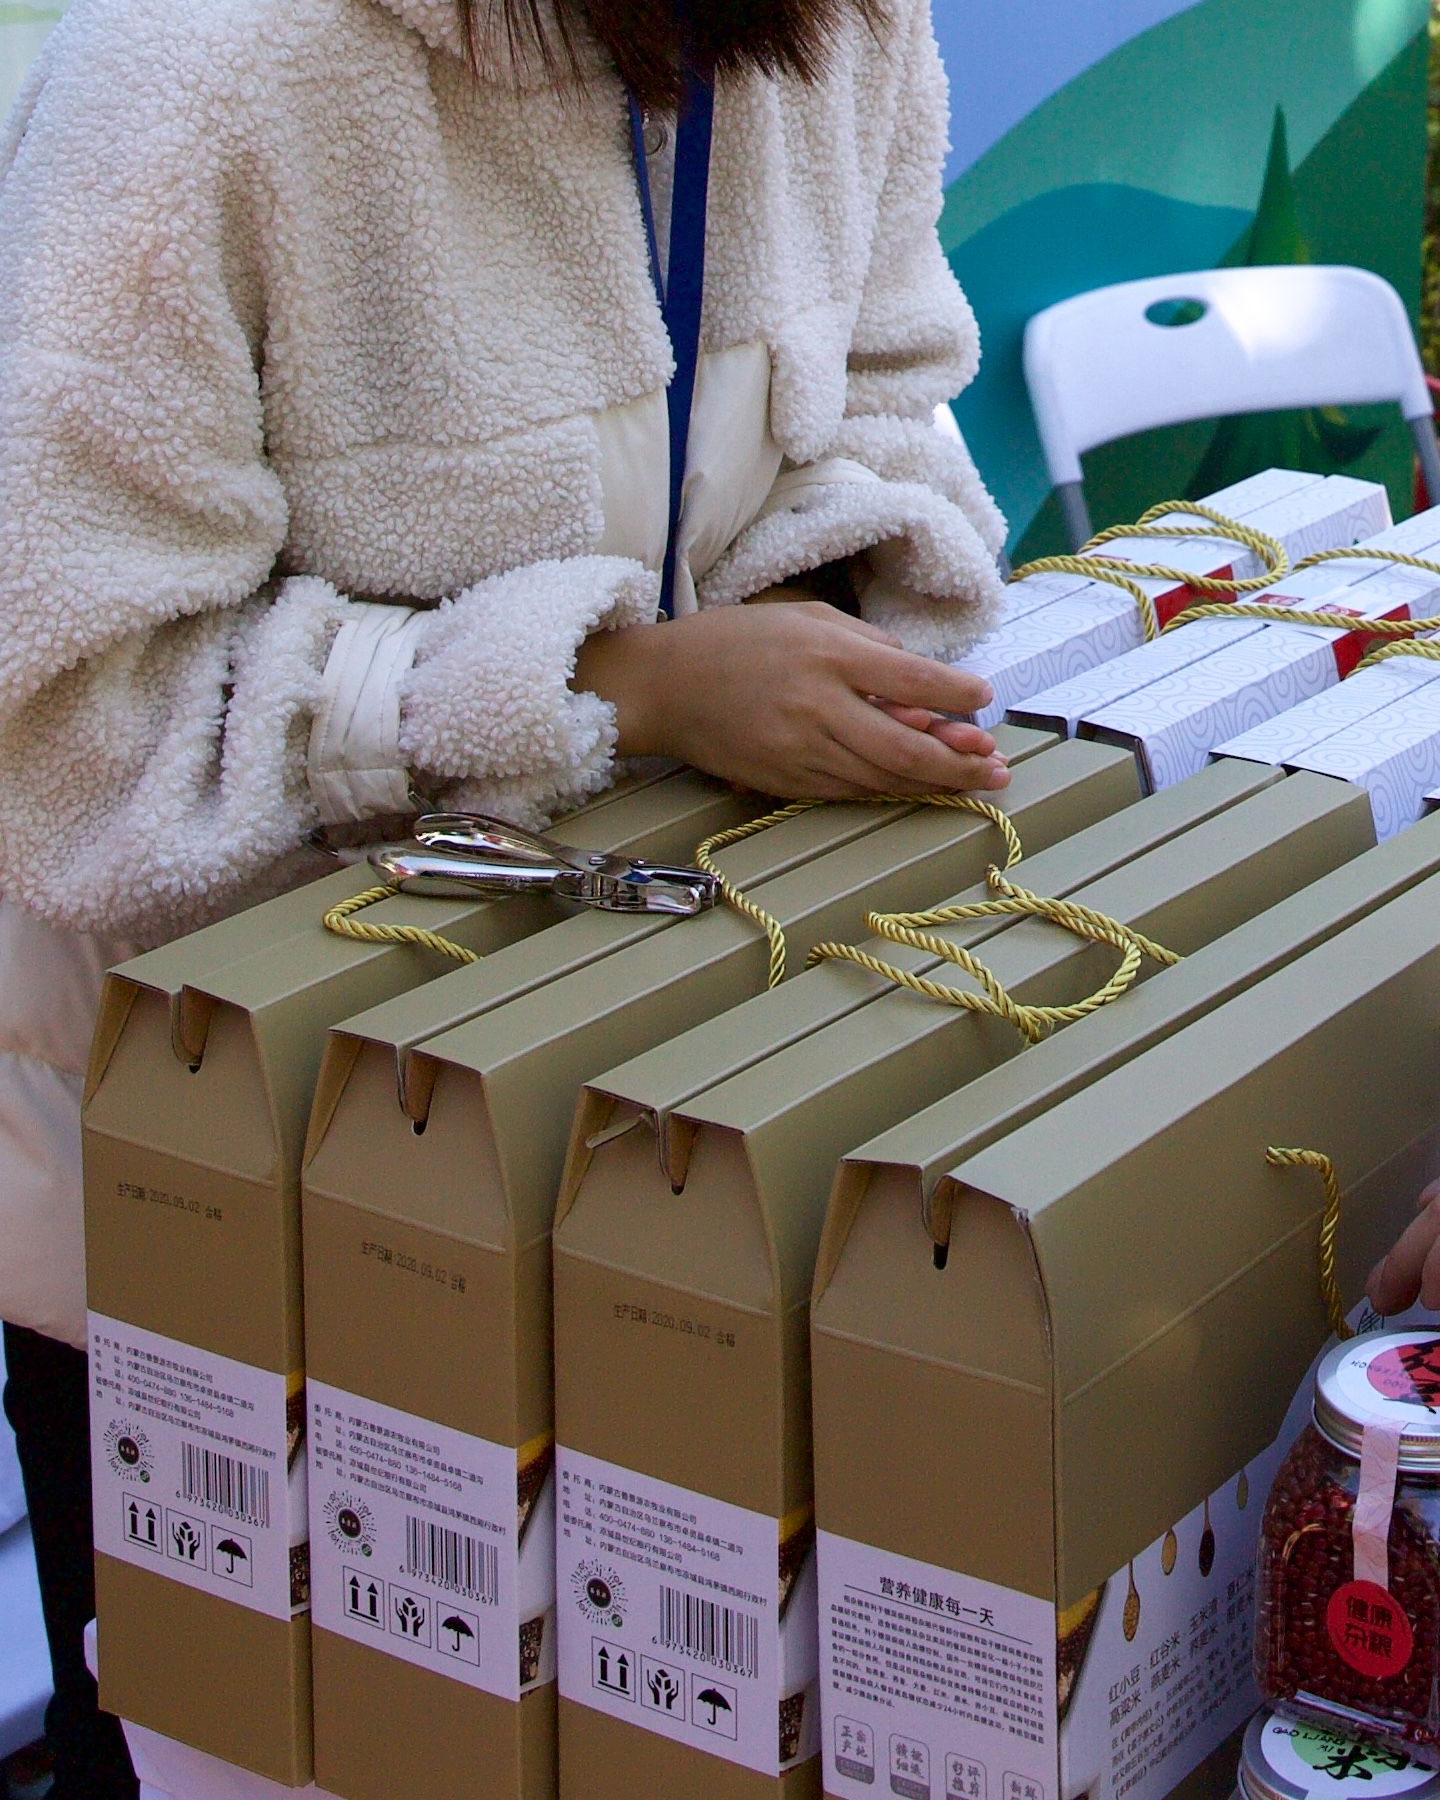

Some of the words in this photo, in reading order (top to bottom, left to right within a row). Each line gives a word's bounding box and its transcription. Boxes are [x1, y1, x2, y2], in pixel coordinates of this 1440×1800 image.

[175, 1490, 182, 1499] 6
[398, 1564, 406, 1574] 6
[878, 1575, 996, 1628] 营养健康每一天
[1345, 1595, 1393, 1631] 健康
[651, 1636, 659, 1645] 6
[664, 1640, 706, 1663] 973420
[1343, 1622, 1393, 1659] 杂粮
[1108, 1663, 1142, 1705] 红小豆
